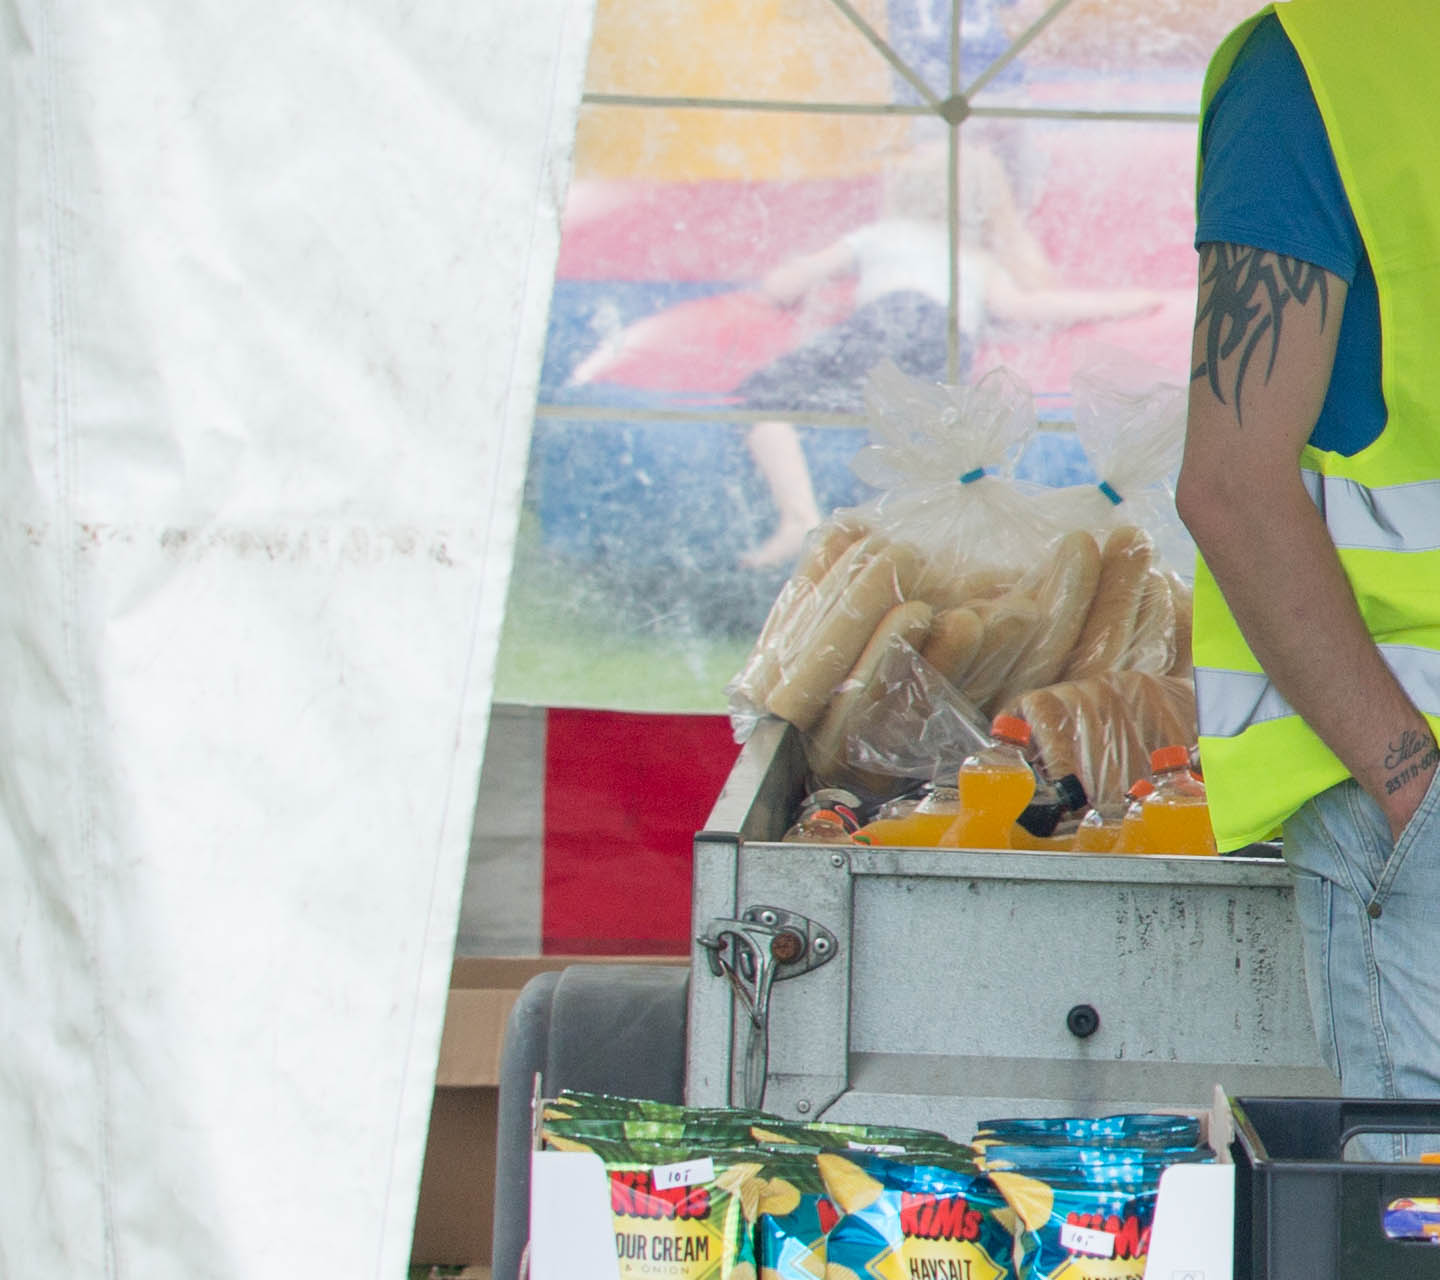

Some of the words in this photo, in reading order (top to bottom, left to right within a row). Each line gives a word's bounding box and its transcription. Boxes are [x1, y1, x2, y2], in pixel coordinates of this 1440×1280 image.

[901, 1191, 985, 1242] KiMs
[616, 1233, 647, 1261] OUR
[652, 1235, 709, 1261] CREAM
